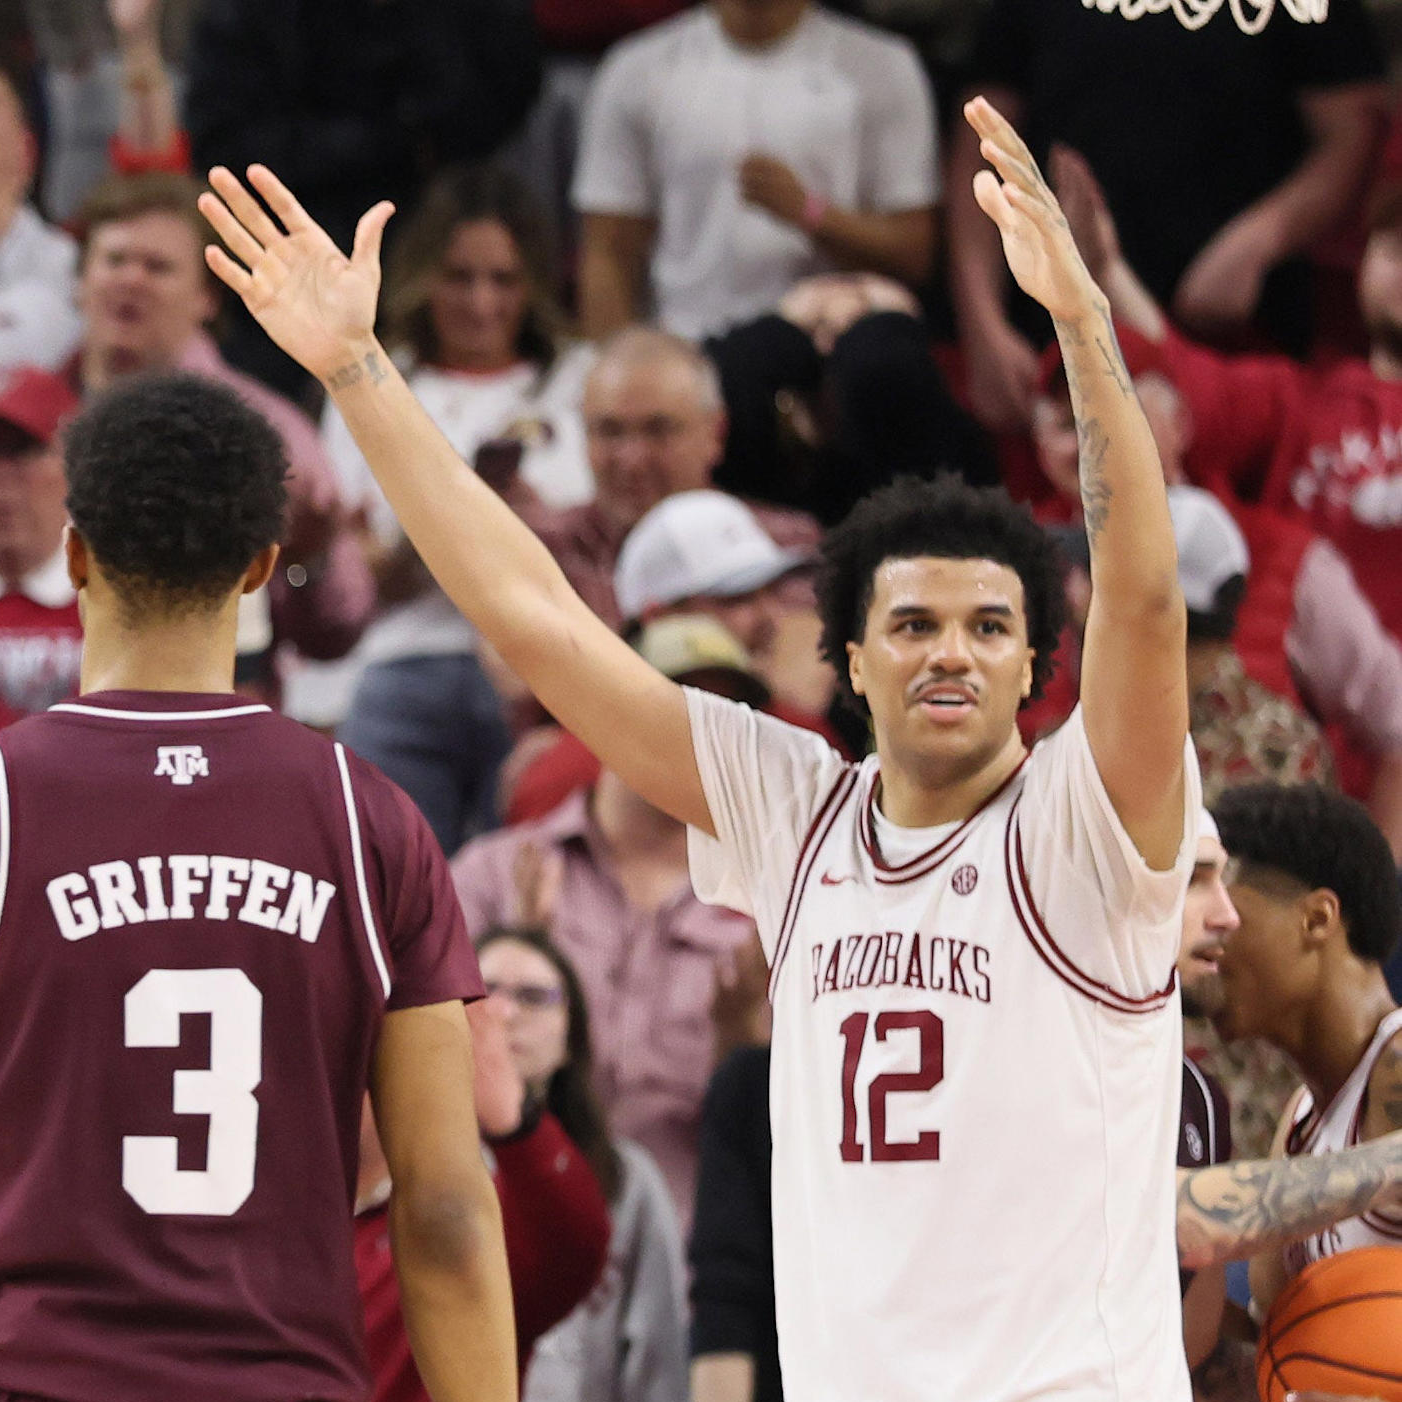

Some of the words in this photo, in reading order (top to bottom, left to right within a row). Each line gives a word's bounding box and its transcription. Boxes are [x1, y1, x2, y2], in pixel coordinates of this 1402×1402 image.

[45, 855, 336, 943] GRIFFEN
[122, 968, 264, 1217] 3
[839, 1009, 944, 1163] 12
